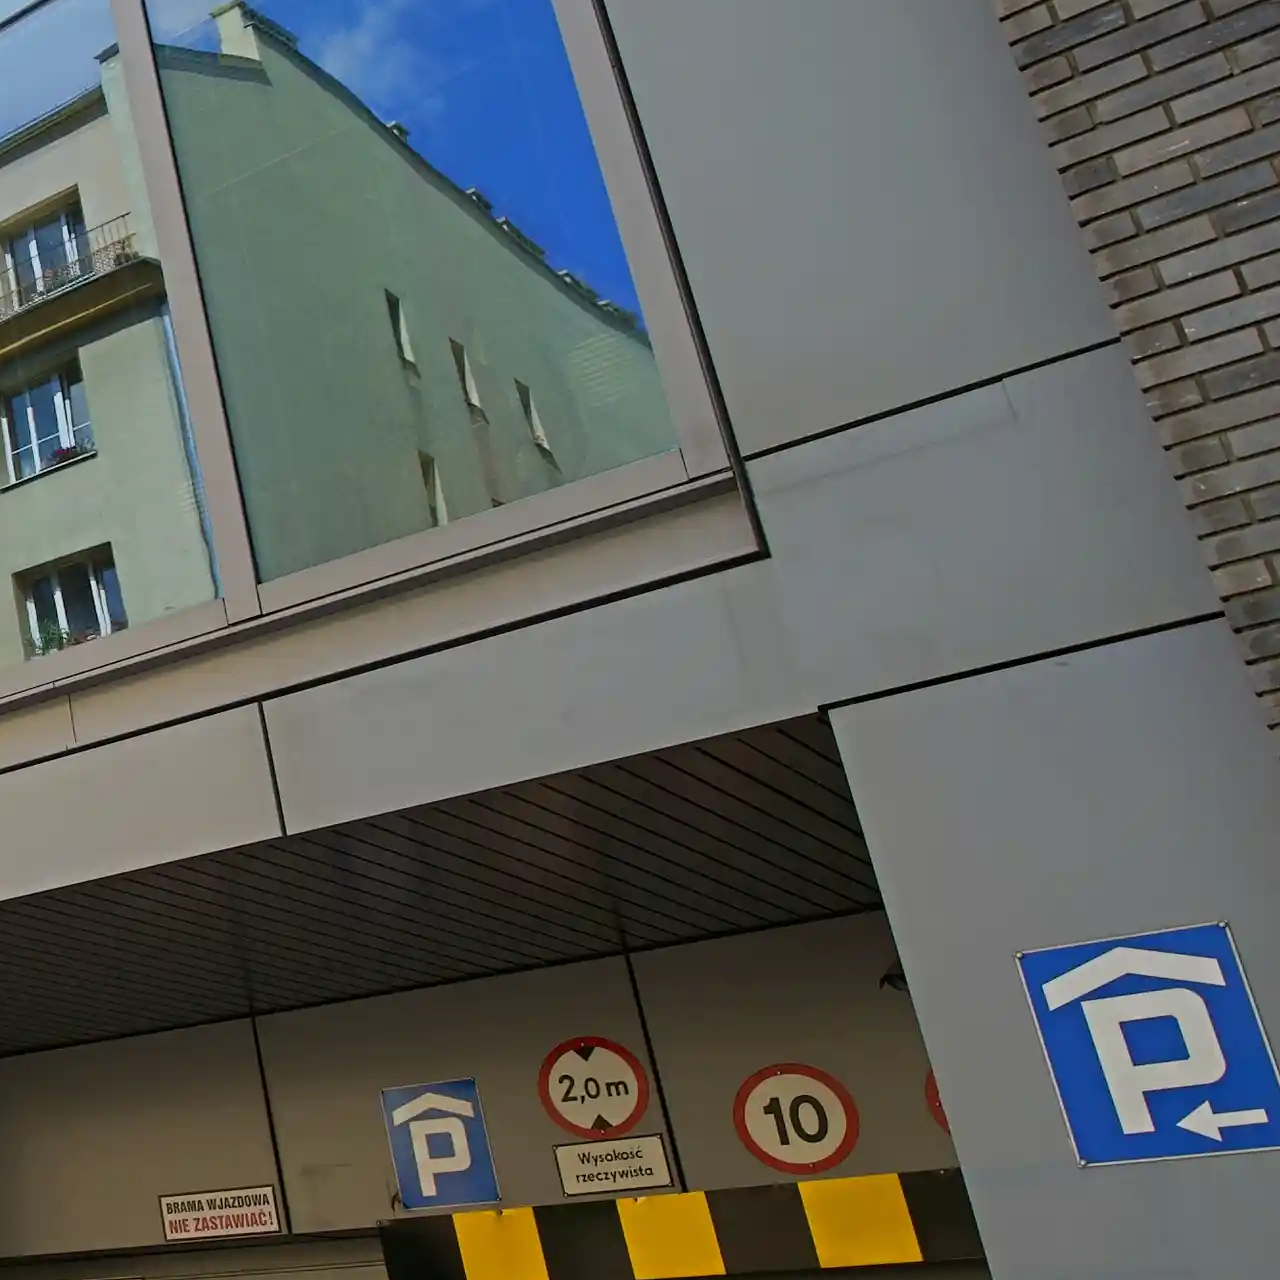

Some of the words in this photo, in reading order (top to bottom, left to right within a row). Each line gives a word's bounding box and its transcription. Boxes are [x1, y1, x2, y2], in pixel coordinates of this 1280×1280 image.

[1081, 988, 1227, 1135] P
[558, 1074, 600, 1105] 2,0
[605, 1080, 630, 1097] m
[763, 1094, 828, 1146] 10
[409, 1117, 471, 1197] P
[577, 1145, 643, 1167] Wysokość
[575, 1165, 654, 1184] rzeczywista
[165, 1199, 205, 1215] BRAMA
[206, 1193, 271, 1211] WJAZDOWA
[168, 1218, 190, 1234] NIE
[193, 1208, 274, 1232] ZASTAWIAĆ!
